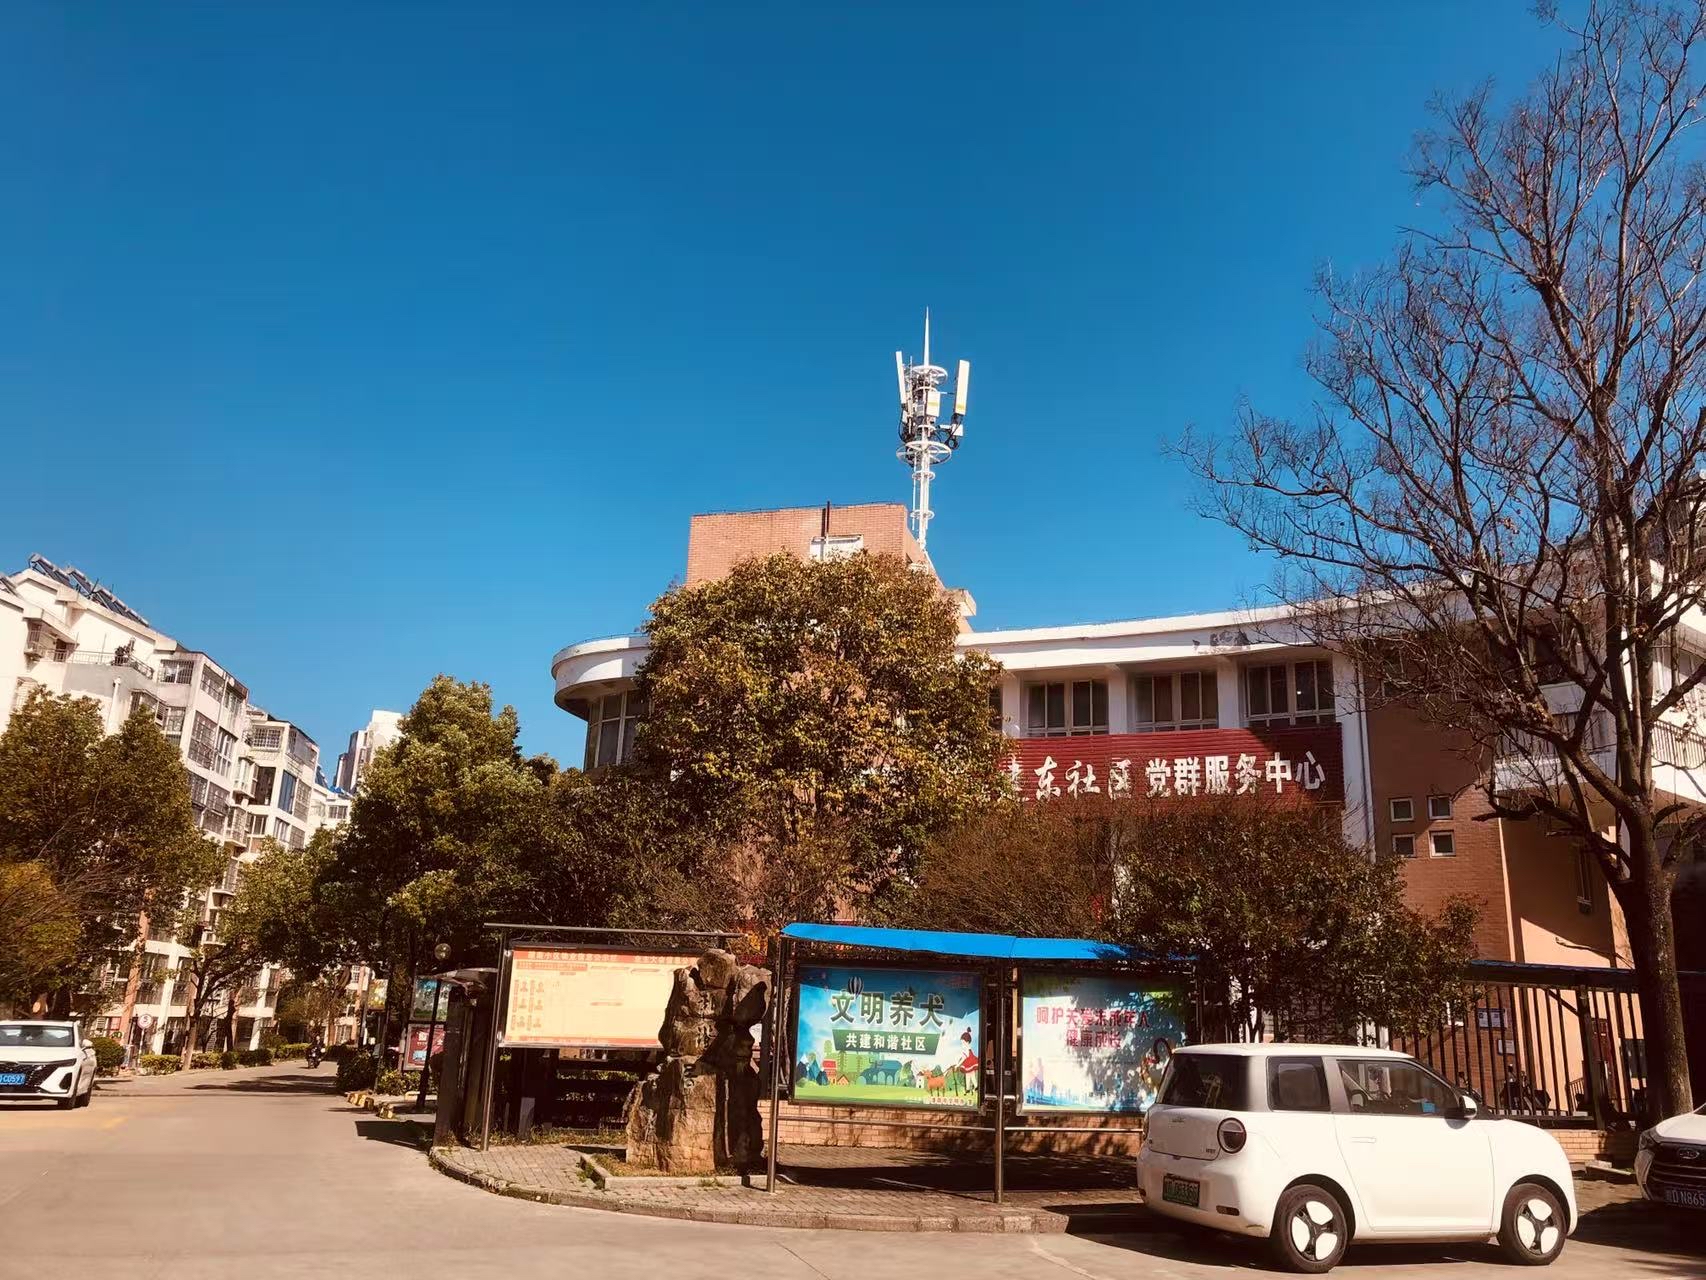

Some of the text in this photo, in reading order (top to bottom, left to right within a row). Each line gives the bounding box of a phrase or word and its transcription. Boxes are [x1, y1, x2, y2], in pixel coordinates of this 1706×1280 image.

[830, 991, 945, 1028] 文明养犬
[1036, 1006, 1150, 1028] 呵护关爱未成年人
[846, 1032, 927, 1051] 共建和谐社区
[1066, 1029, 1122, 1049] 健康成长
